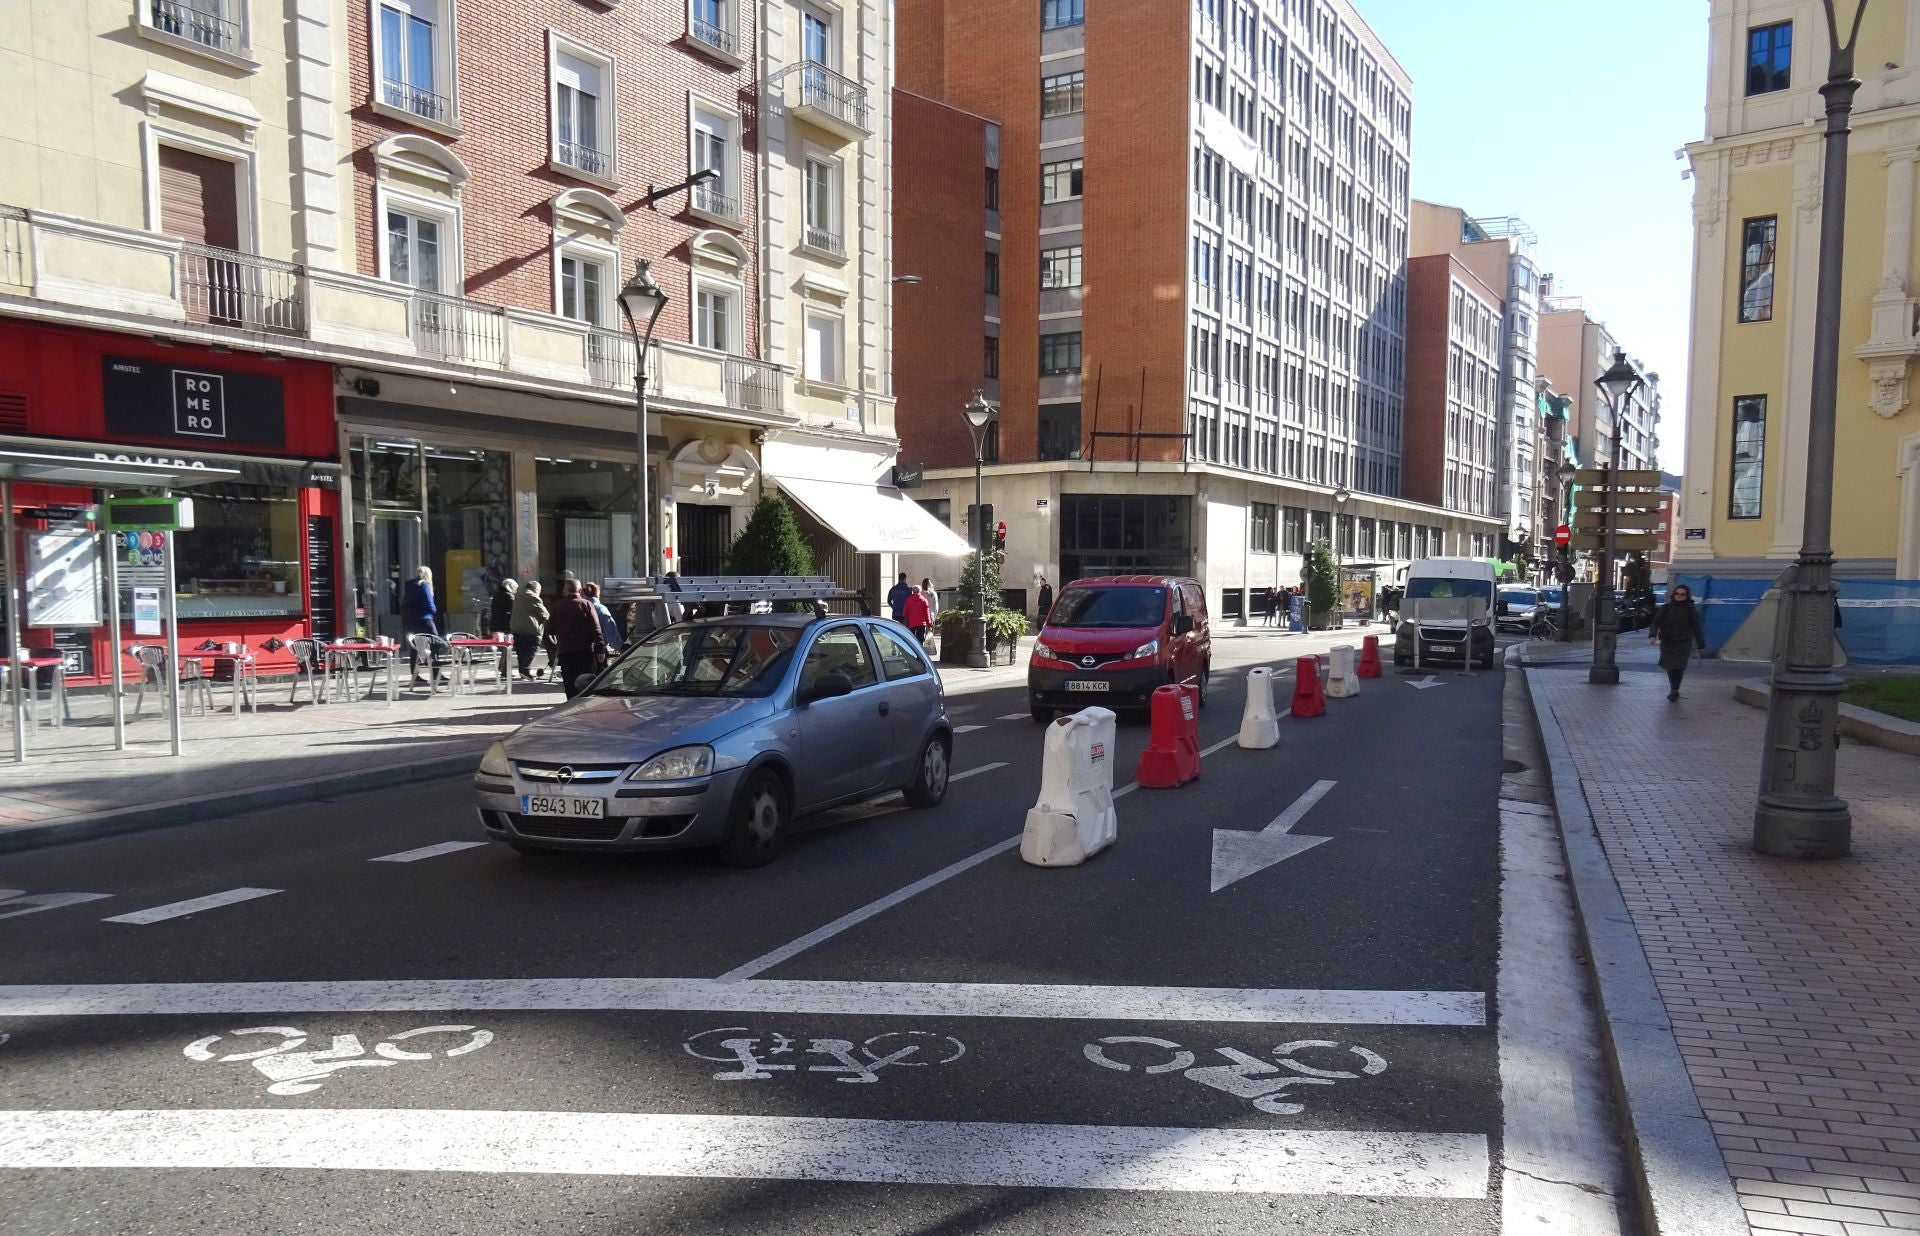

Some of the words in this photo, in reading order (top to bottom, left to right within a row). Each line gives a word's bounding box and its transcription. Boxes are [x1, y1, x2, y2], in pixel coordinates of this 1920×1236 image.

[112, 364, 142, 374] AMSTEL
[186, 378, 211, 393] RO
[186, 397, 211, 411] ME
[187, 415, 213, 429] RO
[1070, 681, 1090, 690] 8814
[1092, 681, 1107, 690] KCK
[531, 797, 566, 814] 6943
[573, 799, 600, 816] DKZ
